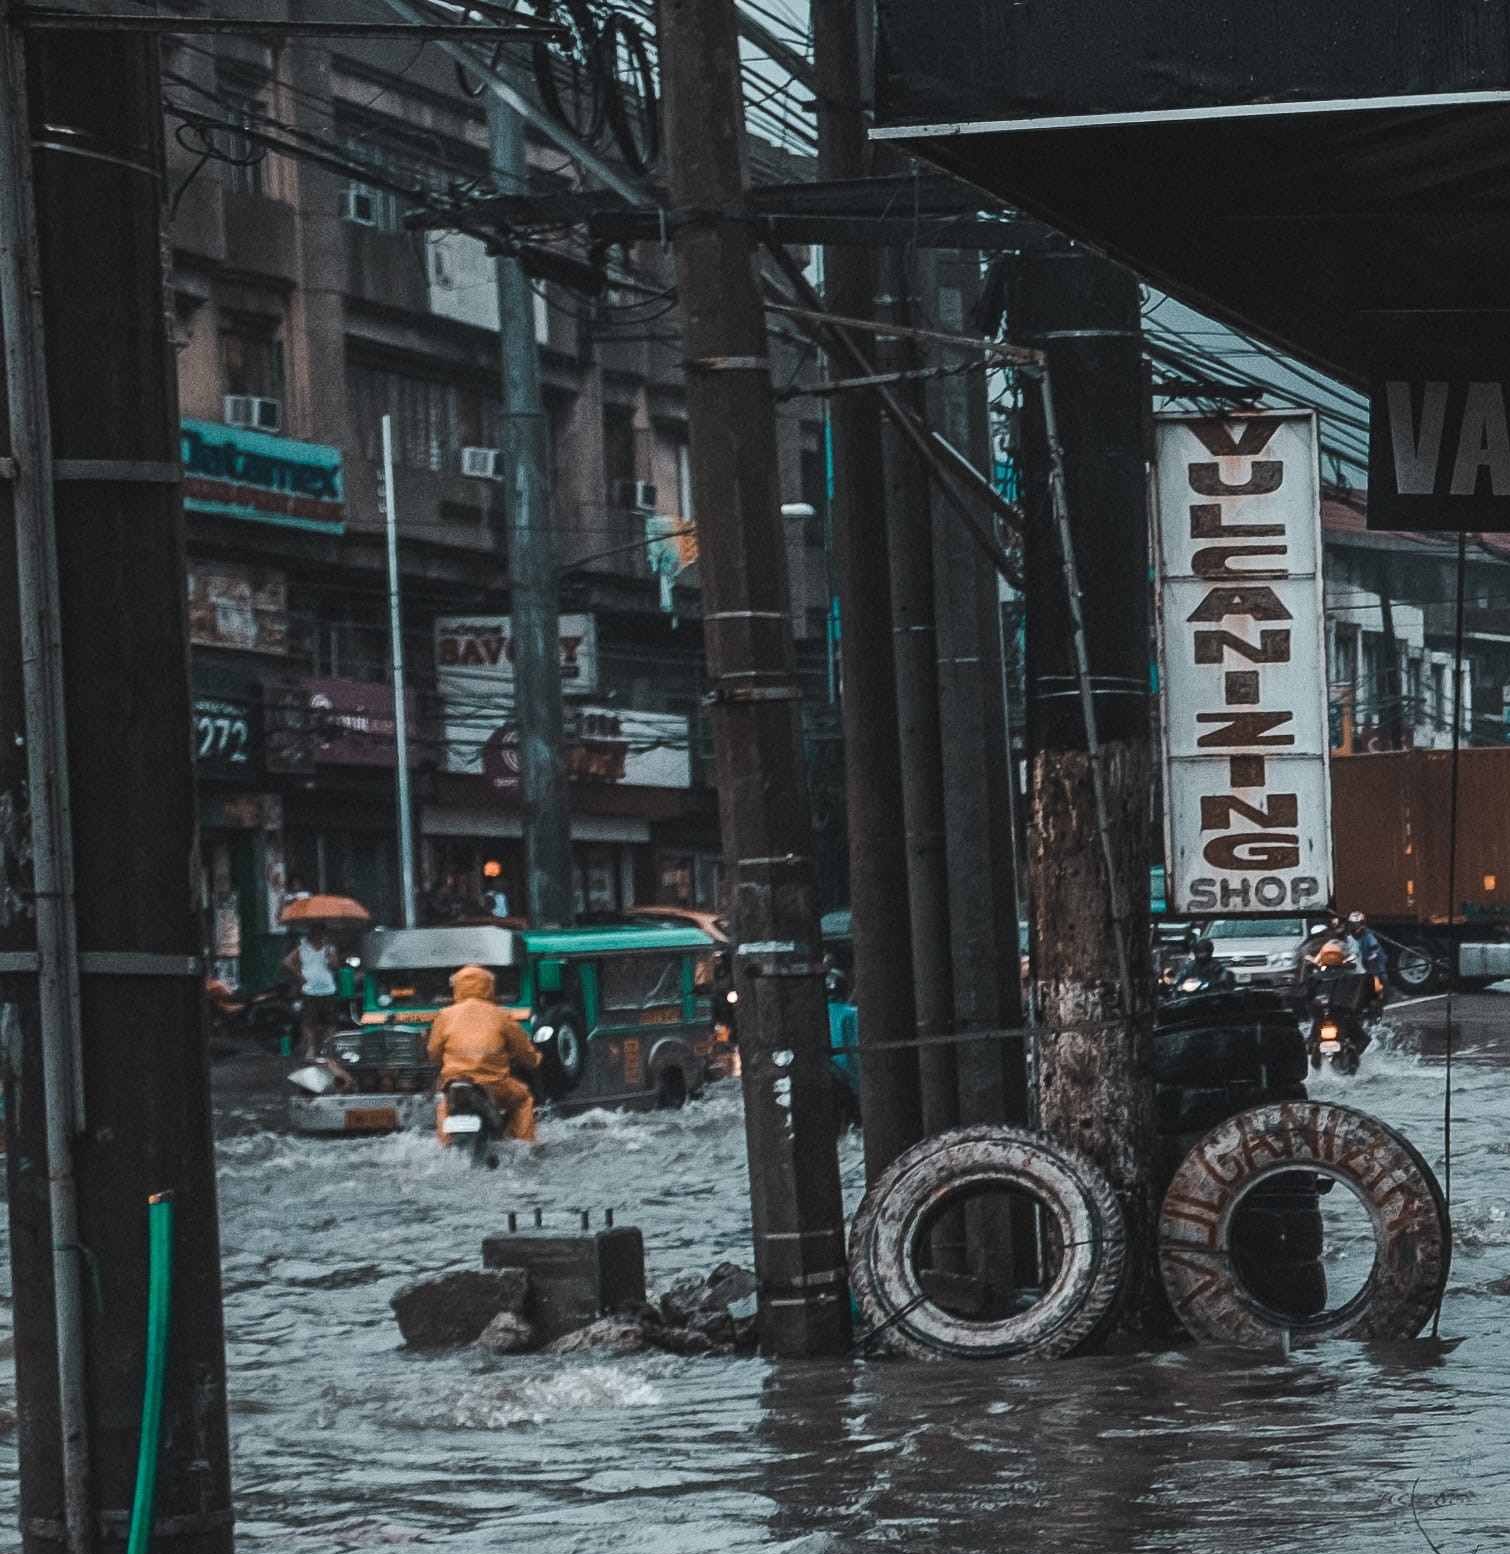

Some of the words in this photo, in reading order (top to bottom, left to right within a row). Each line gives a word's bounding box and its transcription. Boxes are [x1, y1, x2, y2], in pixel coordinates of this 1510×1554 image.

[439, 635, 582, 666] SAVY
[1186, 421, 1300, 870] VULCANIZING
[1188, 876, 1320, 912] SHOP
